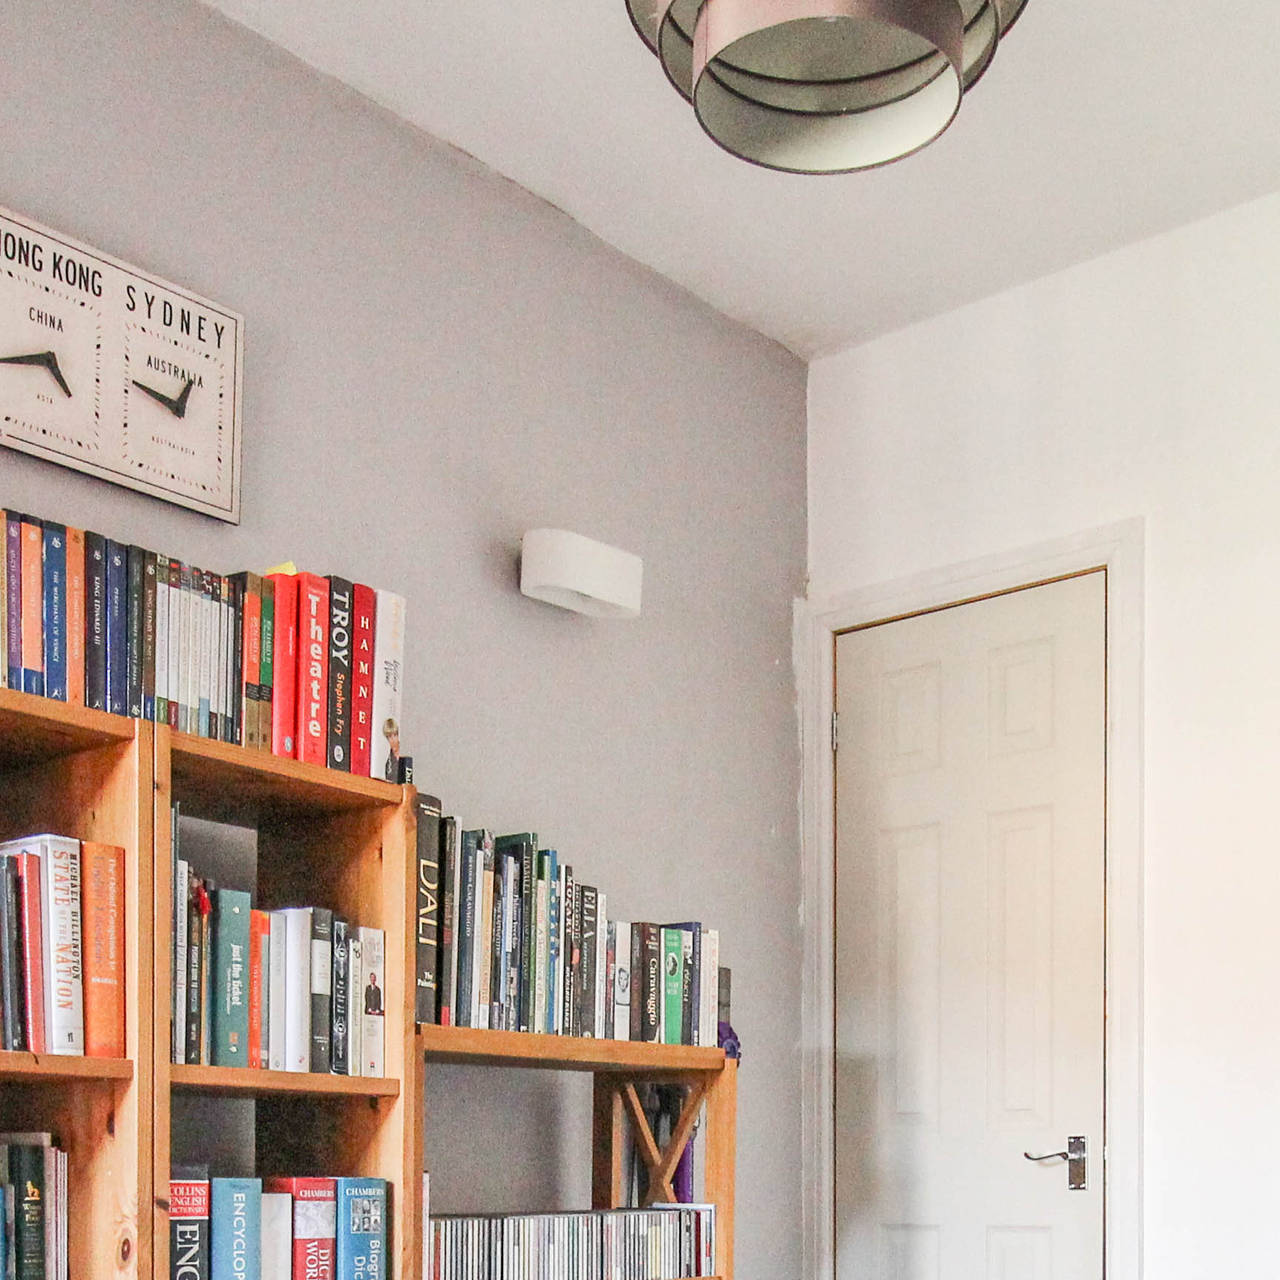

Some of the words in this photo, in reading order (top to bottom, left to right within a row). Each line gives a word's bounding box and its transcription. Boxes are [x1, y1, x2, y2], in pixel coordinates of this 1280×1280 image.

[52, 251, 103, 297] KONG
[29, 307, 64, 333] CHINA
[126, 285, 225, 349] SYDNEY
[146, 355, 204, 389] AUSTRALIA
[53, 625, 59, 634] OF
[332, 591, 349, 666] TROY
[308, 593, 323, 737] Theatre
[358, 615, 370, 750] HAMNET
[335, 672, 345, 715] Stephen
[335, 717, 344, 736] Fry
[53, 849, 70, 906] STATE
[69, 853, 78, 903] MICHAEL
[108, 877, 116, 906] Oxford
[419, 857, 439, 946] DALI
[583, 890, 596, 939] ELLA
[71, 910, 80, 980] BILLINGTON
[107, 909, 117, 959] Companion
[231, 943, 243, 961] just
[56, 943, 73, 1010] NATION
[231, 980, 243, 1005] ticket
[232, 964, 243, 978] the
[647, 957, 657, 1026] Caravaggio
[299, 1189, 334, 1198] CHAMBERS
[345, 1187, 385, 1196] CHAMBERS
